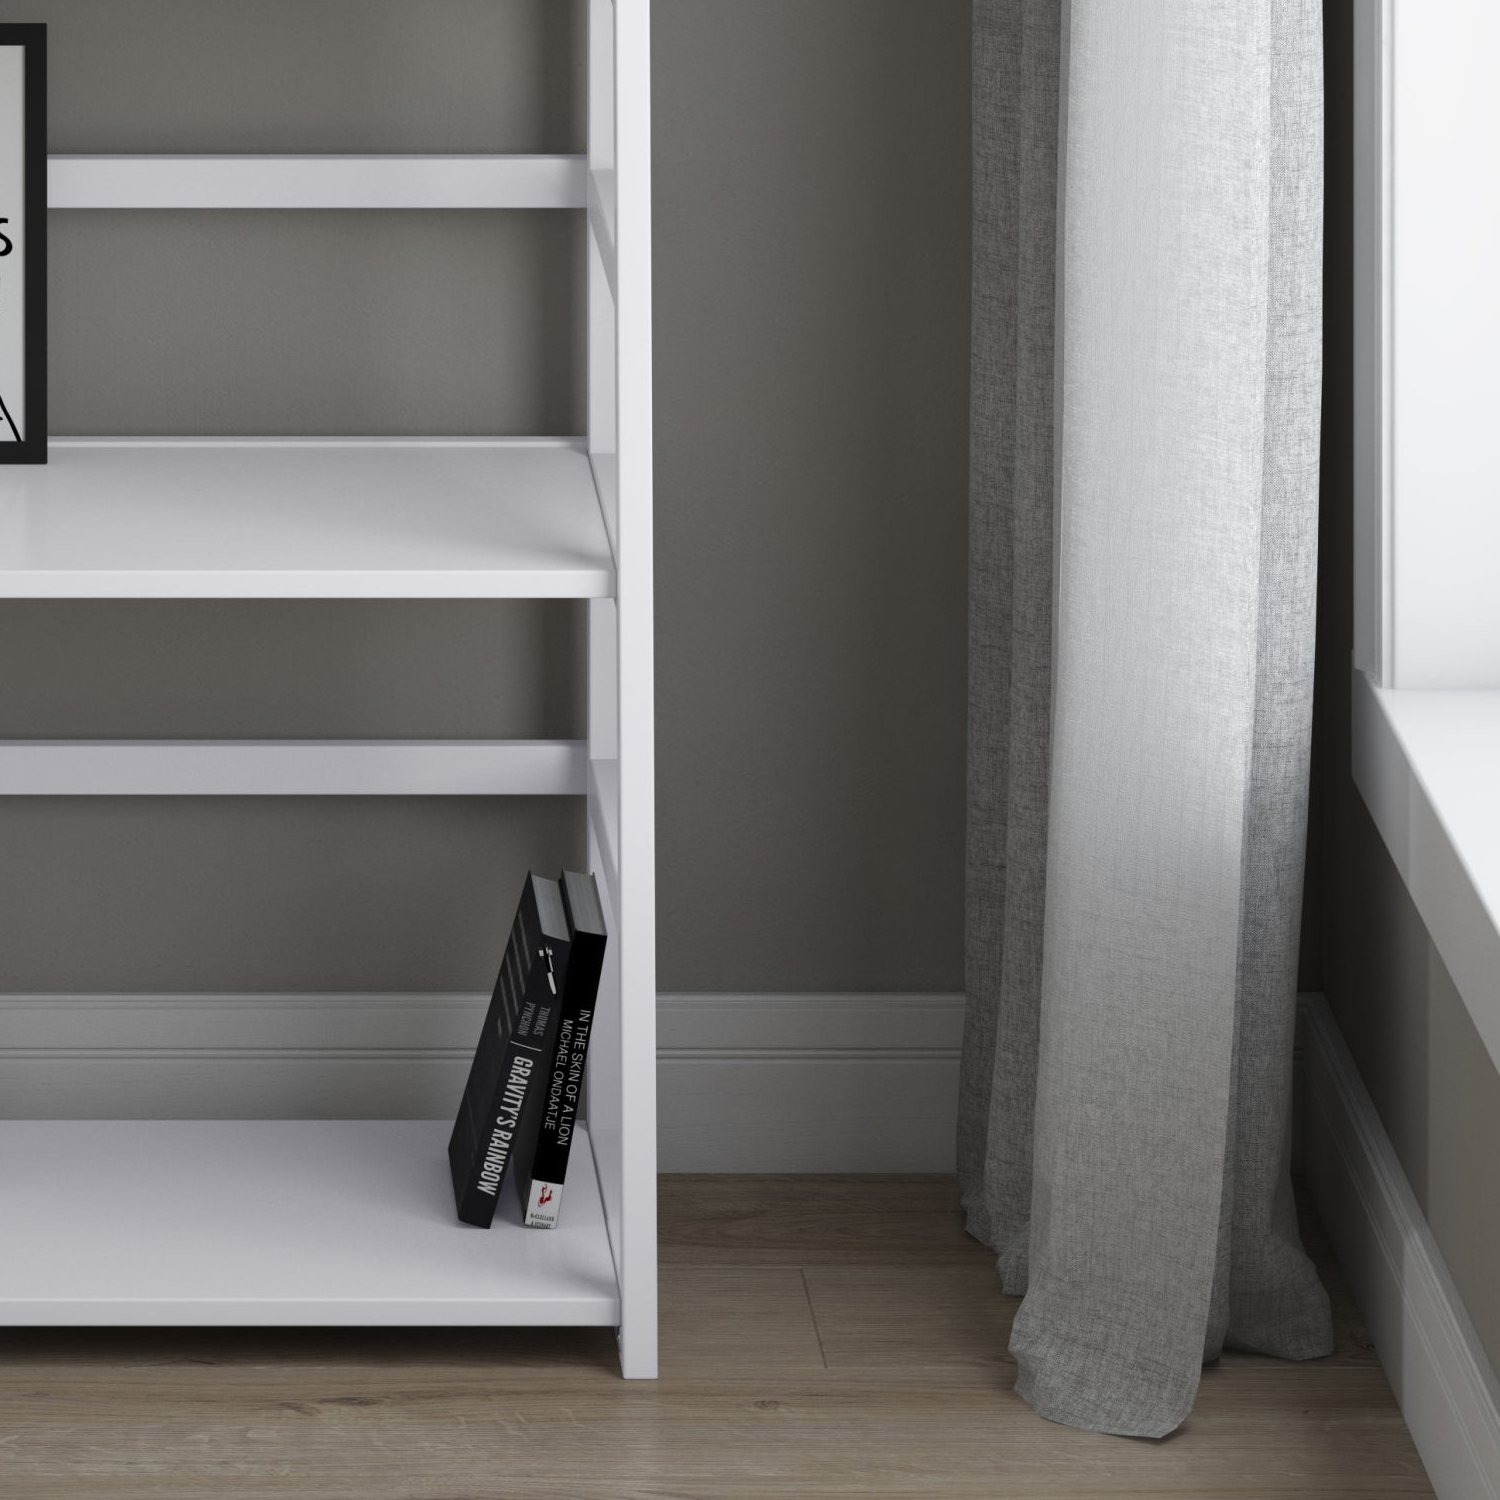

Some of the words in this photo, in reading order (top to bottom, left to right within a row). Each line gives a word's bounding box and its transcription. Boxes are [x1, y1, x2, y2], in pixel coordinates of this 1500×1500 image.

[518, 1001, 536, 1037] PYNCHON
[533, 1006, 550, 1037] THOMAS
[579, 1009, 591, 1023] IN
[555, 1018, 574, 1068] MICHAEL
[573, 1024, 589, 1050] THE
[568, 1052, 583, 1083] SKIN
[496, 1055, 533, 1128] GRAVITY'S
[544, 1070, 564, 1131] ONDAATJE
[565, 1085, 578, 1102] OF
[563, 1104, 574, 1113] A
[557, 1118, 573, 1146] LION
[477, 1128, 513, 1197] RAINBOW
